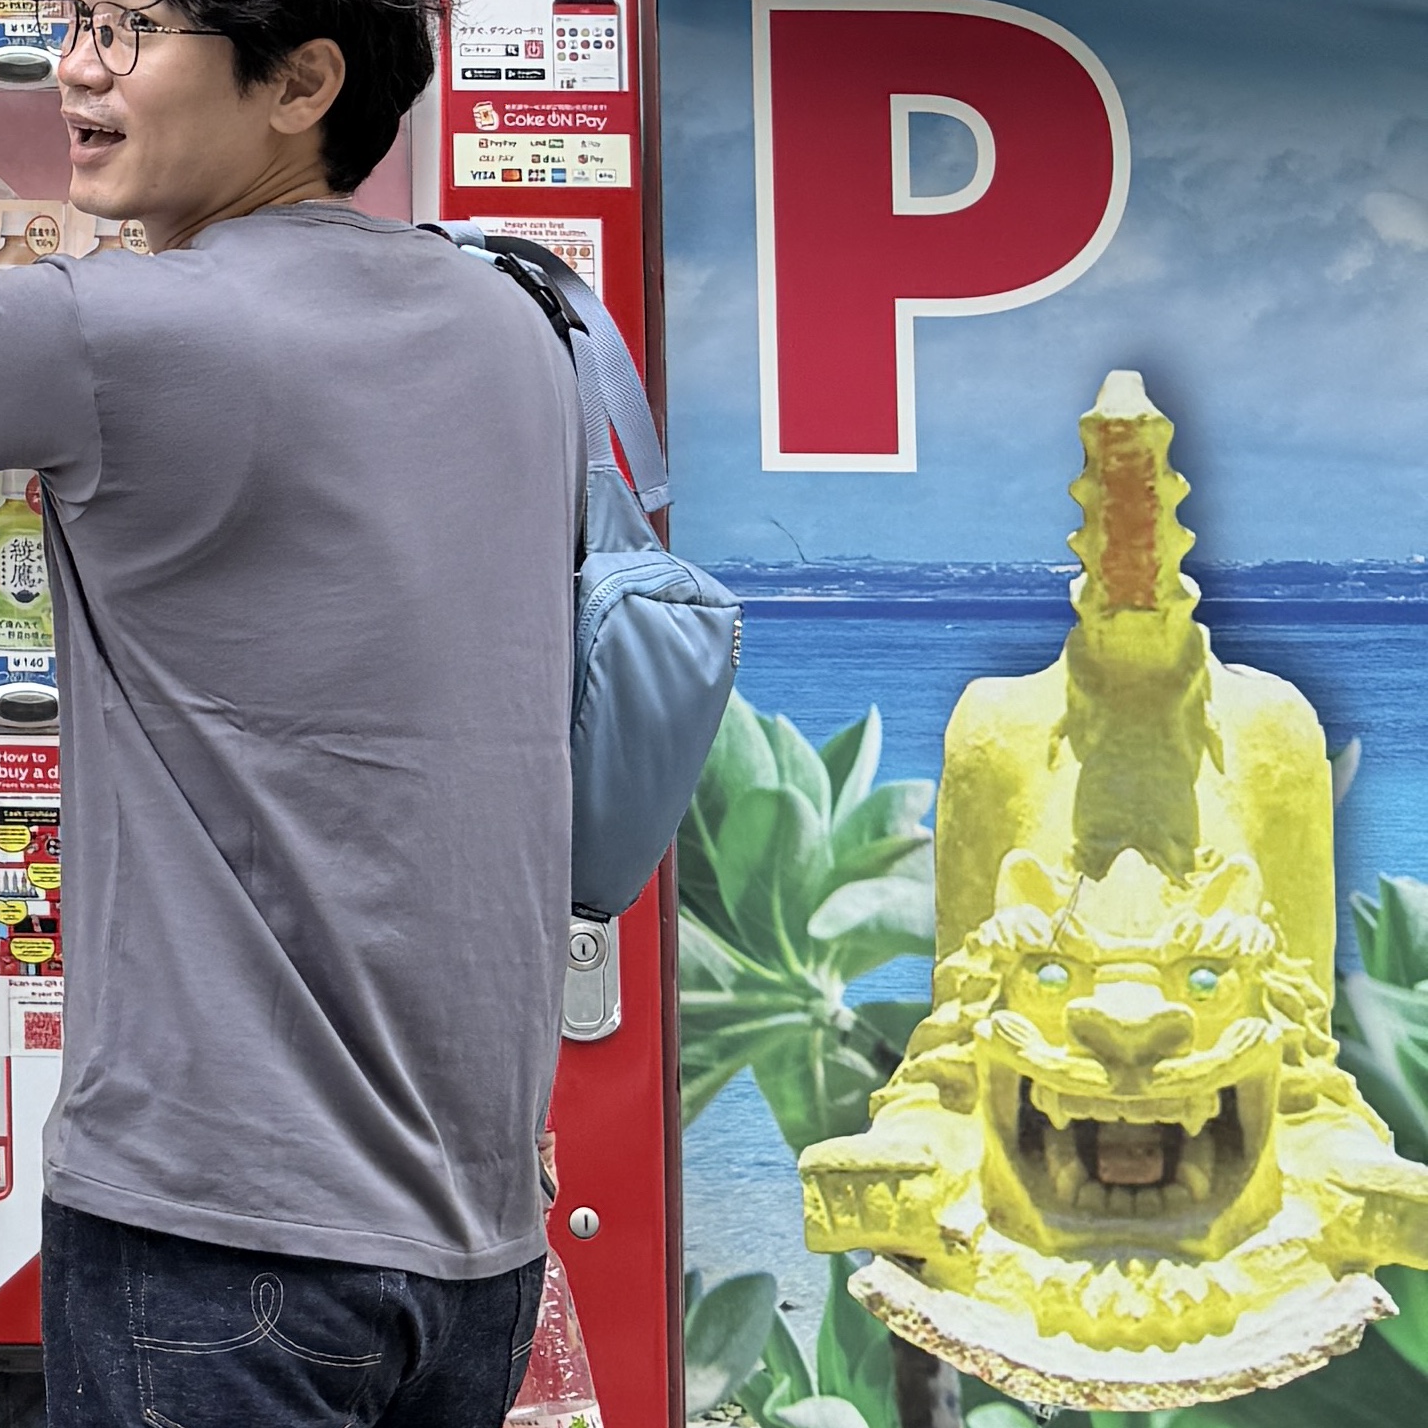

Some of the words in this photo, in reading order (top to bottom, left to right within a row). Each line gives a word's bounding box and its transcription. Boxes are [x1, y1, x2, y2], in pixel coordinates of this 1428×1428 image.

[503, 113, 545, 128] Coke
[547, 110, 574, 128] ON
[575, 114, 607, 132] Pay
[30, 752, 47, 763] to
